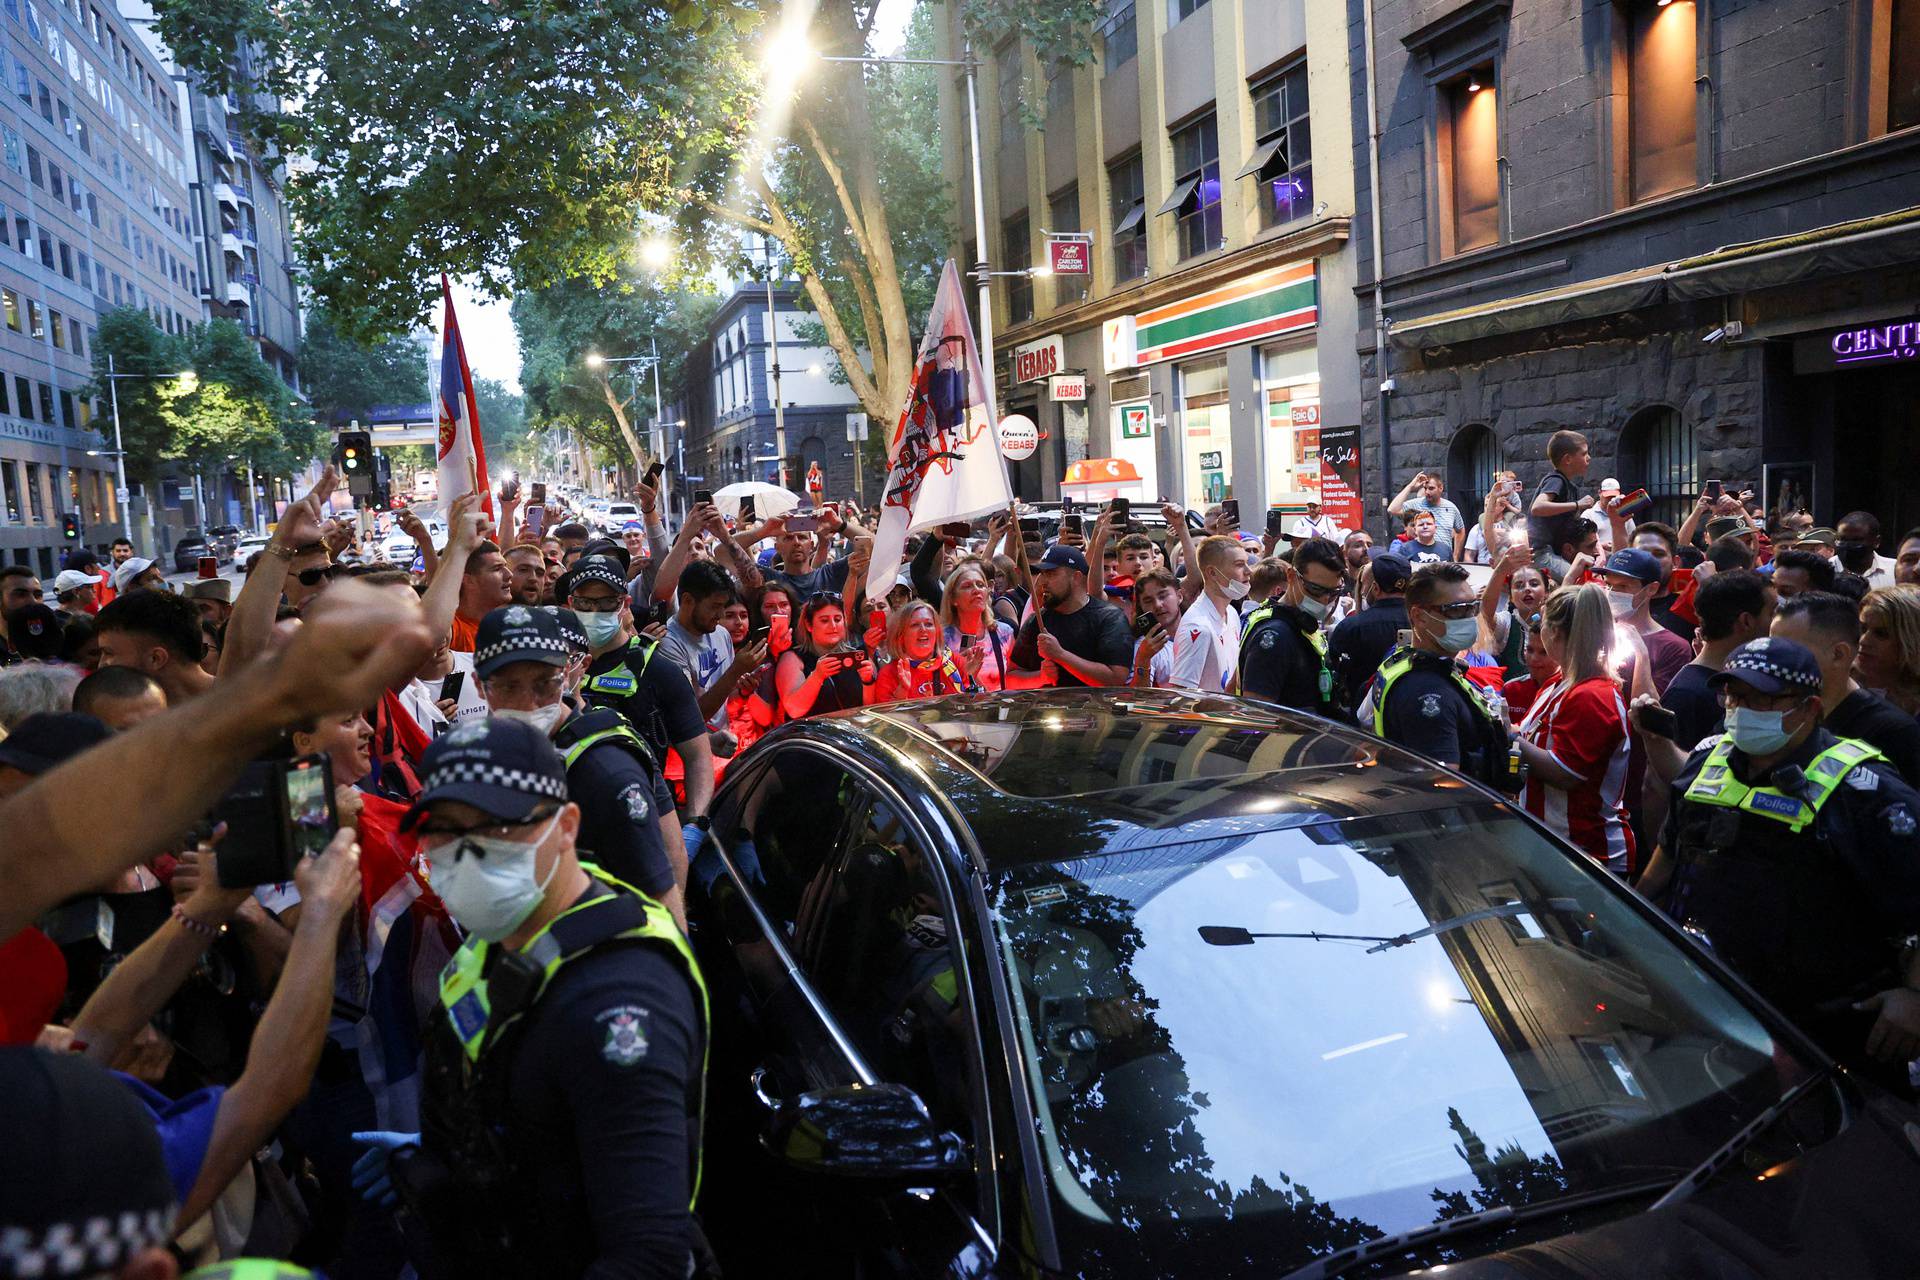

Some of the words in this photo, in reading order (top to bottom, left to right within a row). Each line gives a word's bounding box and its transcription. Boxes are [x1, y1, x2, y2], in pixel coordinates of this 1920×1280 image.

[1017, 345, 1057, 382] KEBABS
[1056, 385, 1082, 398] KEBABS
[1001, 430, 1034, 438] Queen's
[1001, 440, 1034, 449] KEBABS
[1321, 447, 1334, 465] For
[1336, 445, 1357, 464] Sale
[1338, 490, 1356, 498] Growing
[600, 677, 628, 687] Police
[1756, 795, 1795, 812] Police
